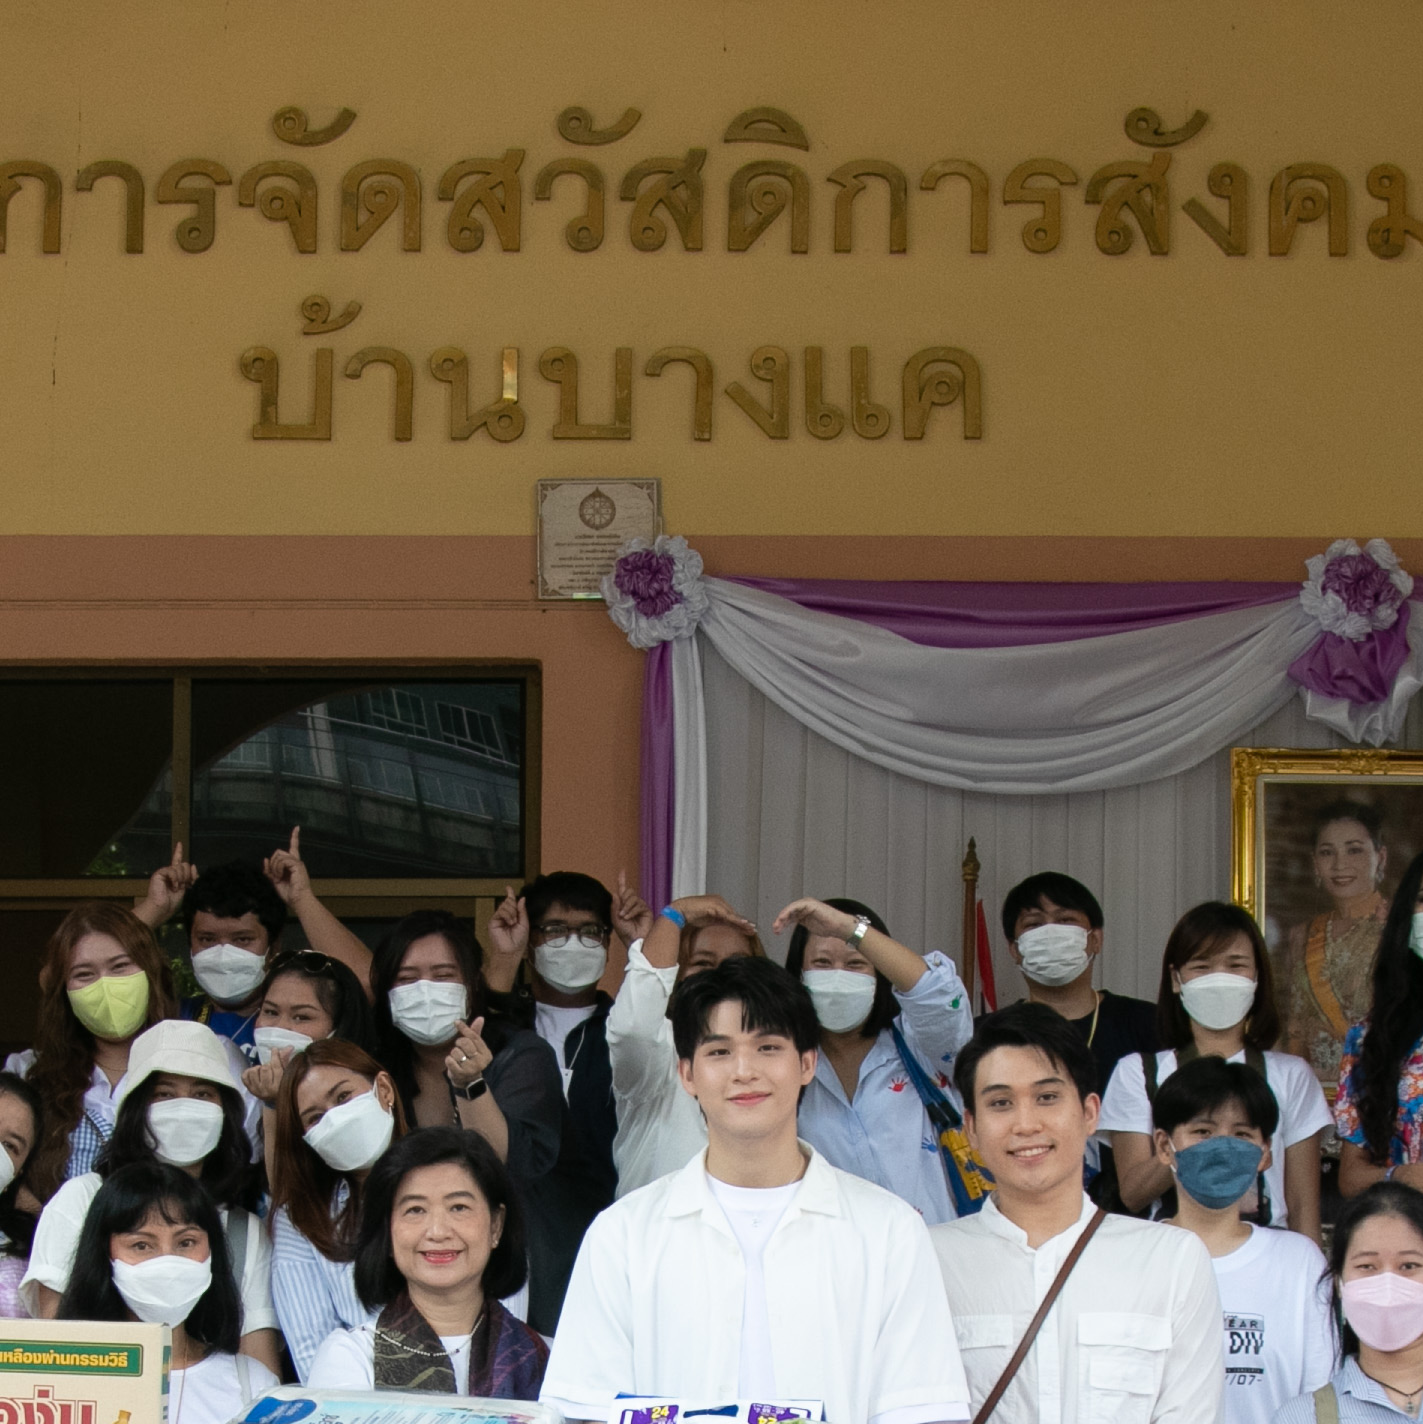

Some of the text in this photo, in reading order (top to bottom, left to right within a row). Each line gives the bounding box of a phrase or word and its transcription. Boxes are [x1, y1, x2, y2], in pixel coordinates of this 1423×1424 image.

[239, 294, 983, 442] บ้านบางแค
[1227, 1318, 1258, 1328] EAR
[651, 1406, 670, 1419] 24
